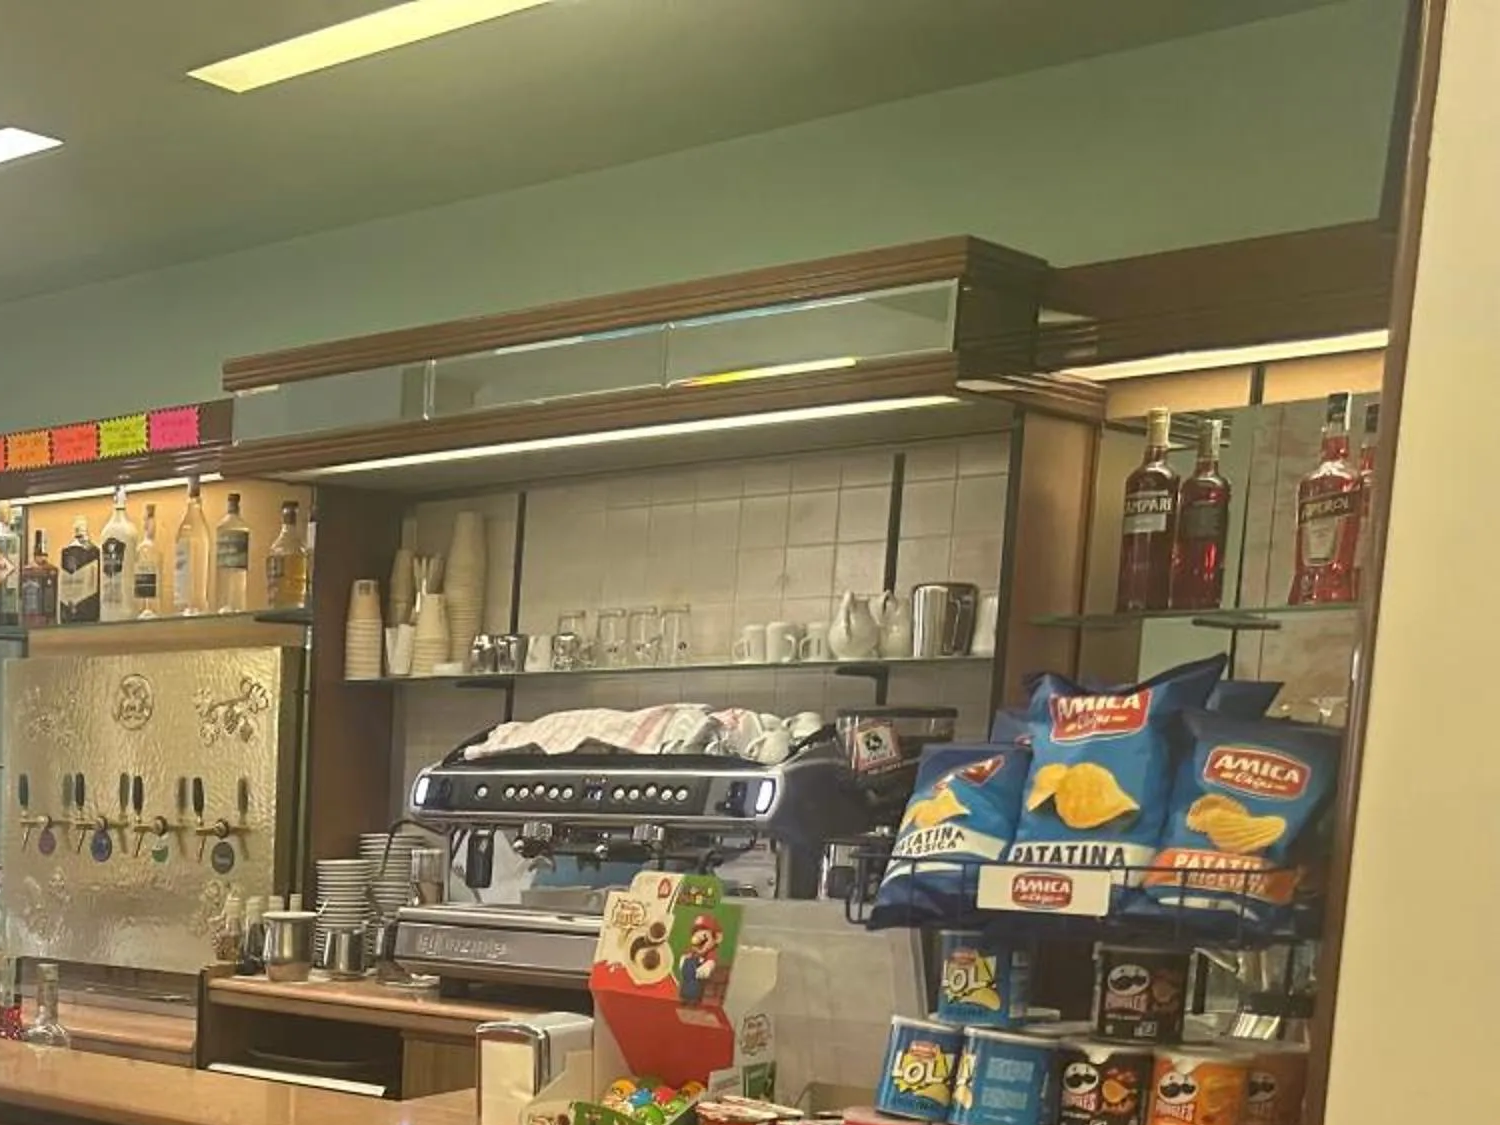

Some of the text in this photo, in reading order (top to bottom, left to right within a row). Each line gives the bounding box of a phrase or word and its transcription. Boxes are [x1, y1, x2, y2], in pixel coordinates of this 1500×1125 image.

[1214, 754, 1299, 784] AMICA
[1013, 845, 1125, 867] PATATINA
[1014, 878, 1070, 893] AMICA
